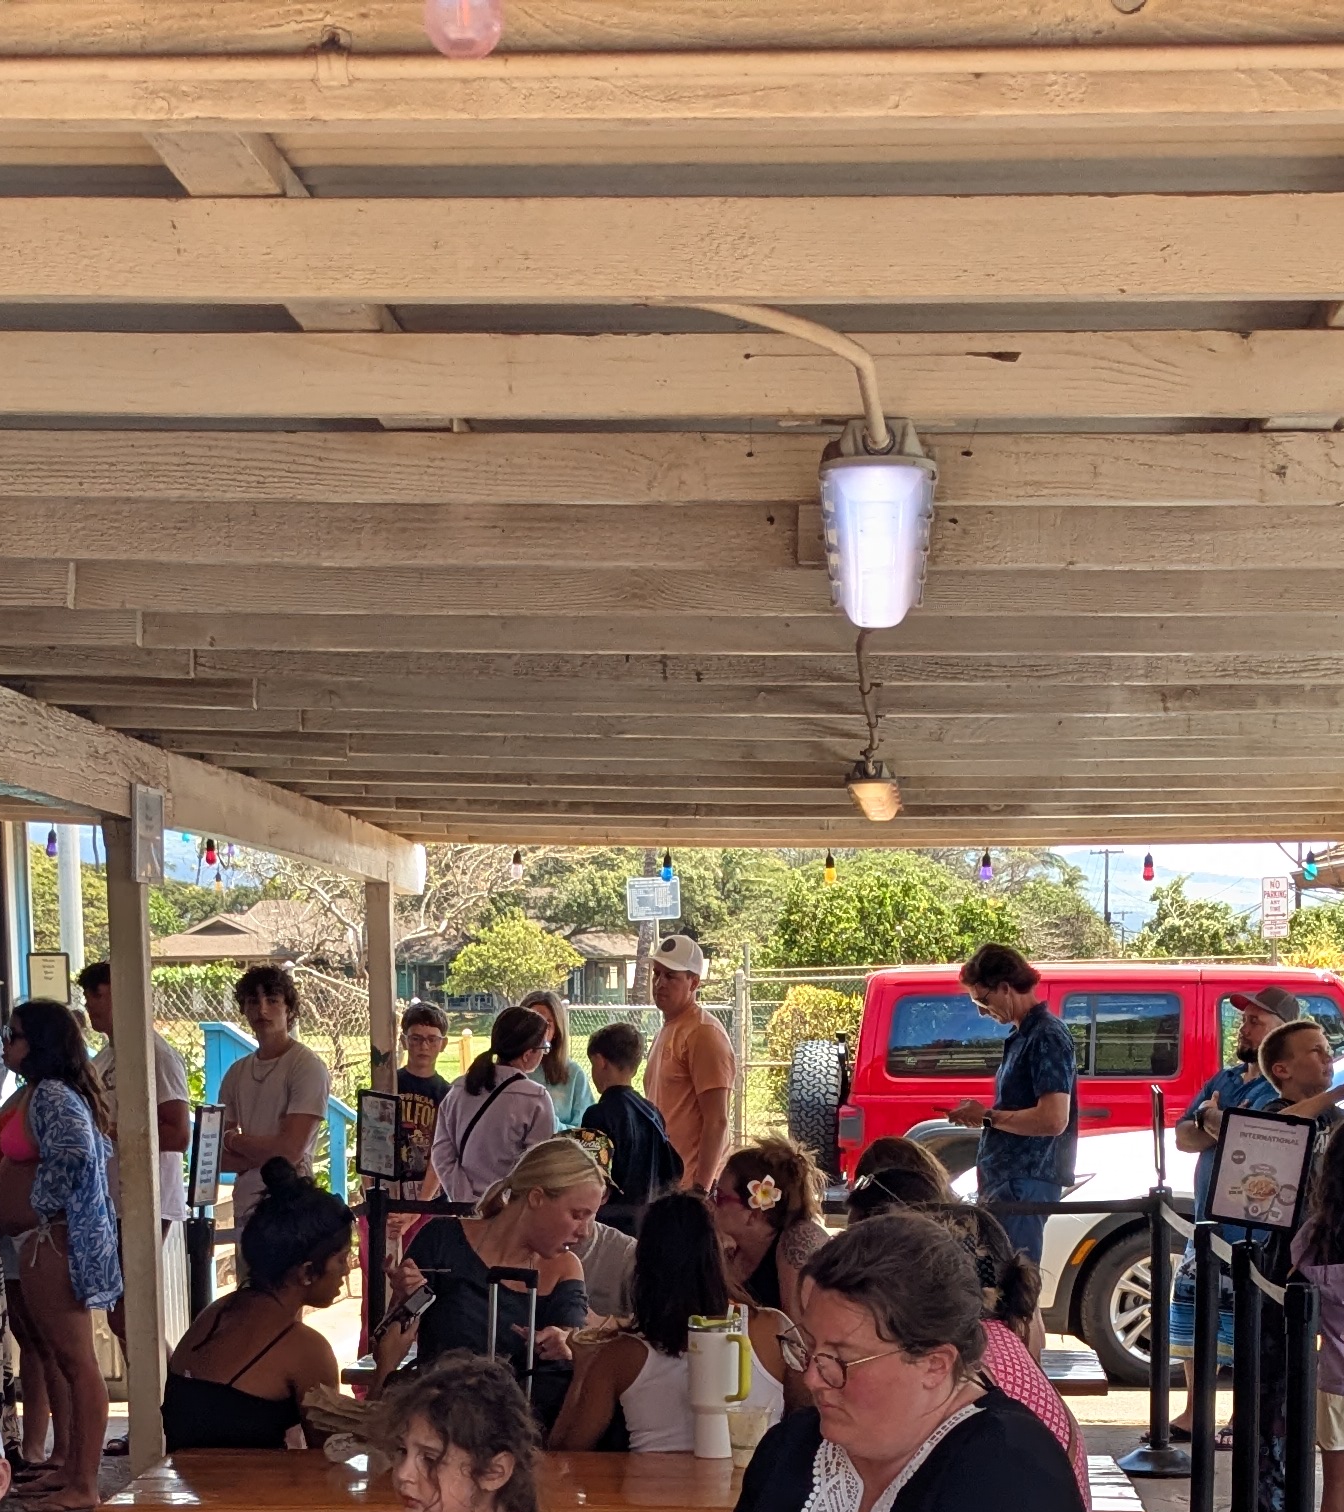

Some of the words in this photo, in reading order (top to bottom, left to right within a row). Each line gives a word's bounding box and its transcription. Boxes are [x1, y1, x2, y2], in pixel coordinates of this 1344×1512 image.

[1270, 881, 1280, 889] NO
[1264, 891, 1287, 899] PARKING
[1240, 1131, 1299, 1146] INTERNATIONAL
